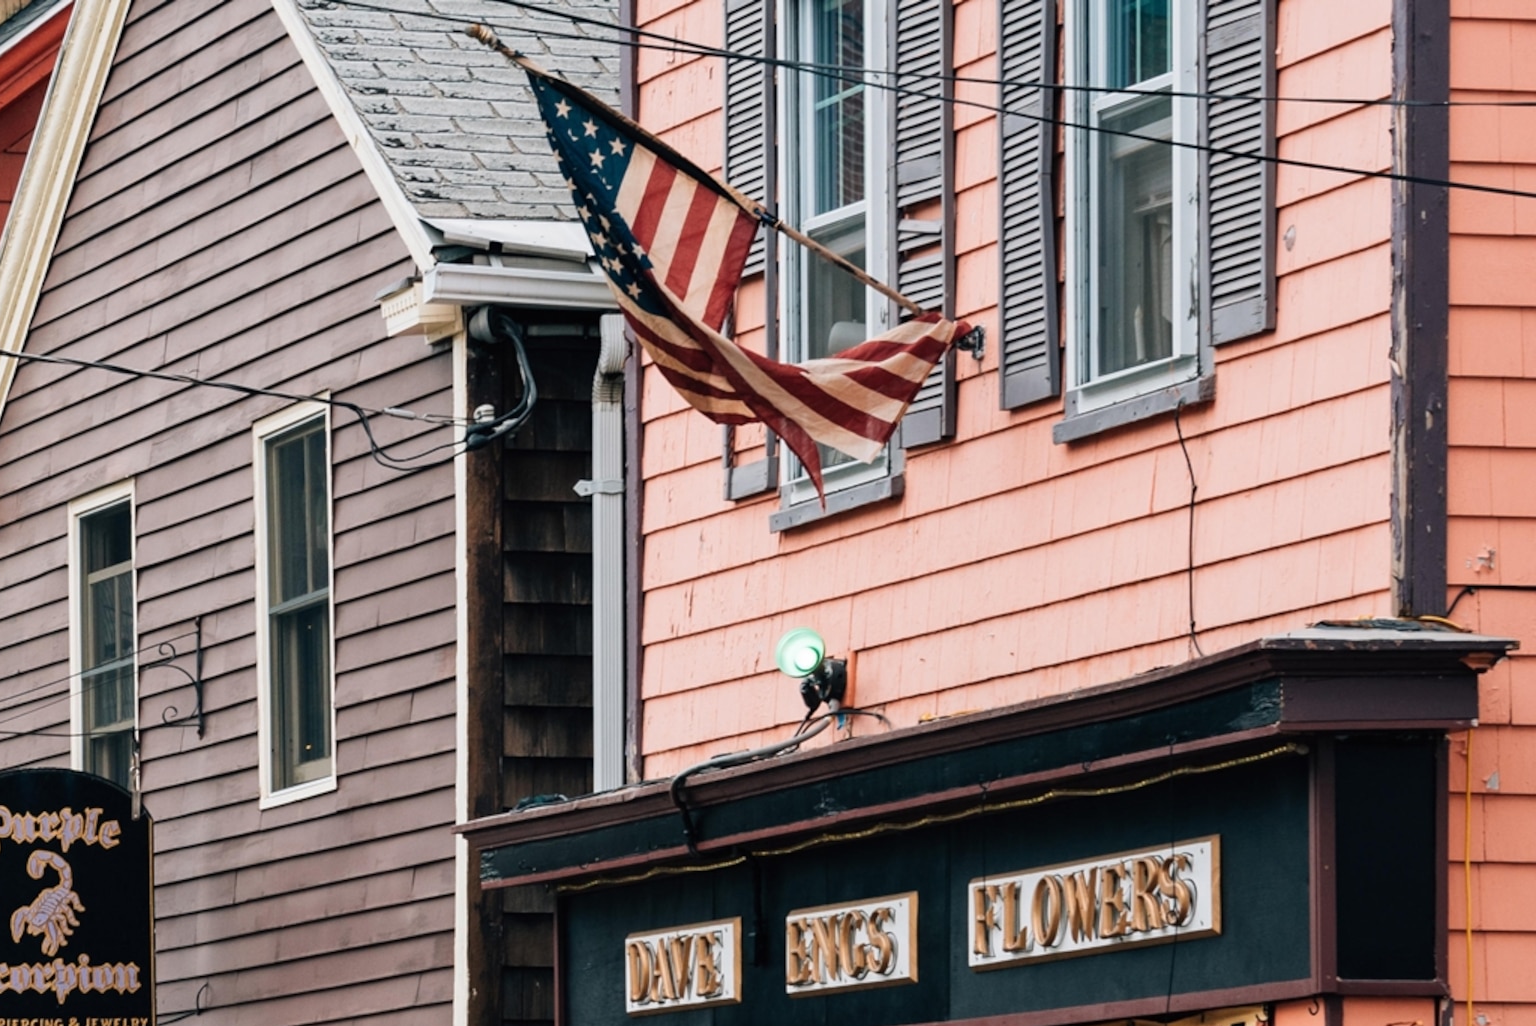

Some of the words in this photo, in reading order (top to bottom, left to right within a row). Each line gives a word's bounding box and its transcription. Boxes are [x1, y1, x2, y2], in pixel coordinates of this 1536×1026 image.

[627, 931, 722, 1004] DAVE
[787, 908, 896, 985] ENGS
[973, 854, 1196, 955] FLOWERS
